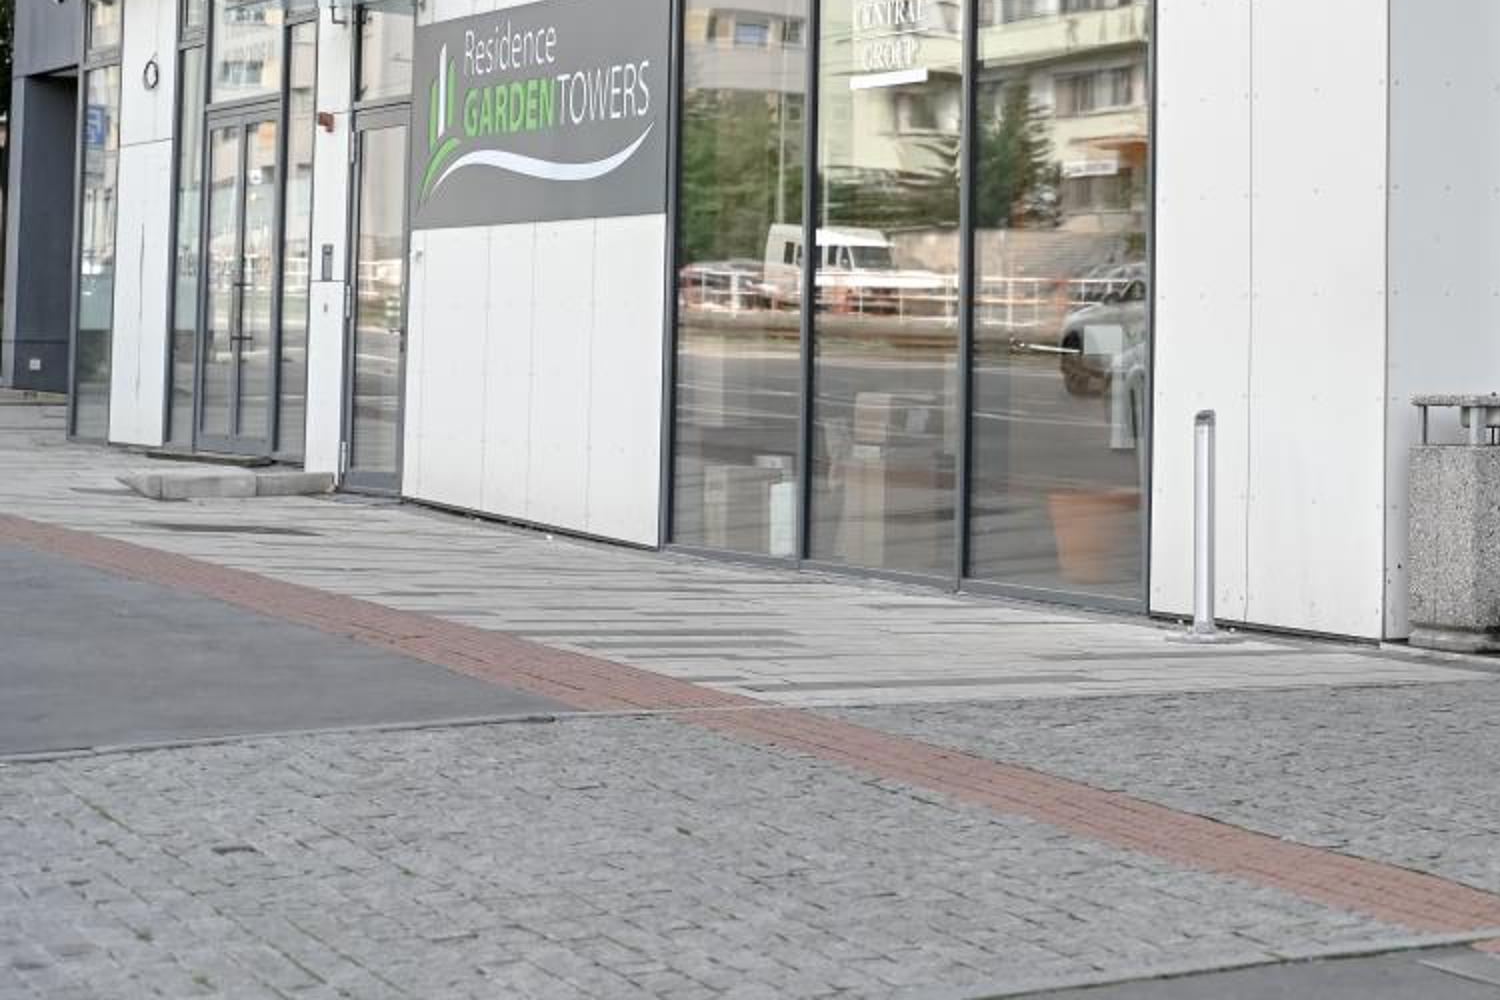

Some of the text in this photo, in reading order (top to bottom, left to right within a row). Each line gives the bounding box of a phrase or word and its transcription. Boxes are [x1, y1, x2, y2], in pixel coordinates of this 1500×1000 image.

[464, 19, 558, 75] Residence
[463, 59, 650, 136] GARDEN TOWERS
